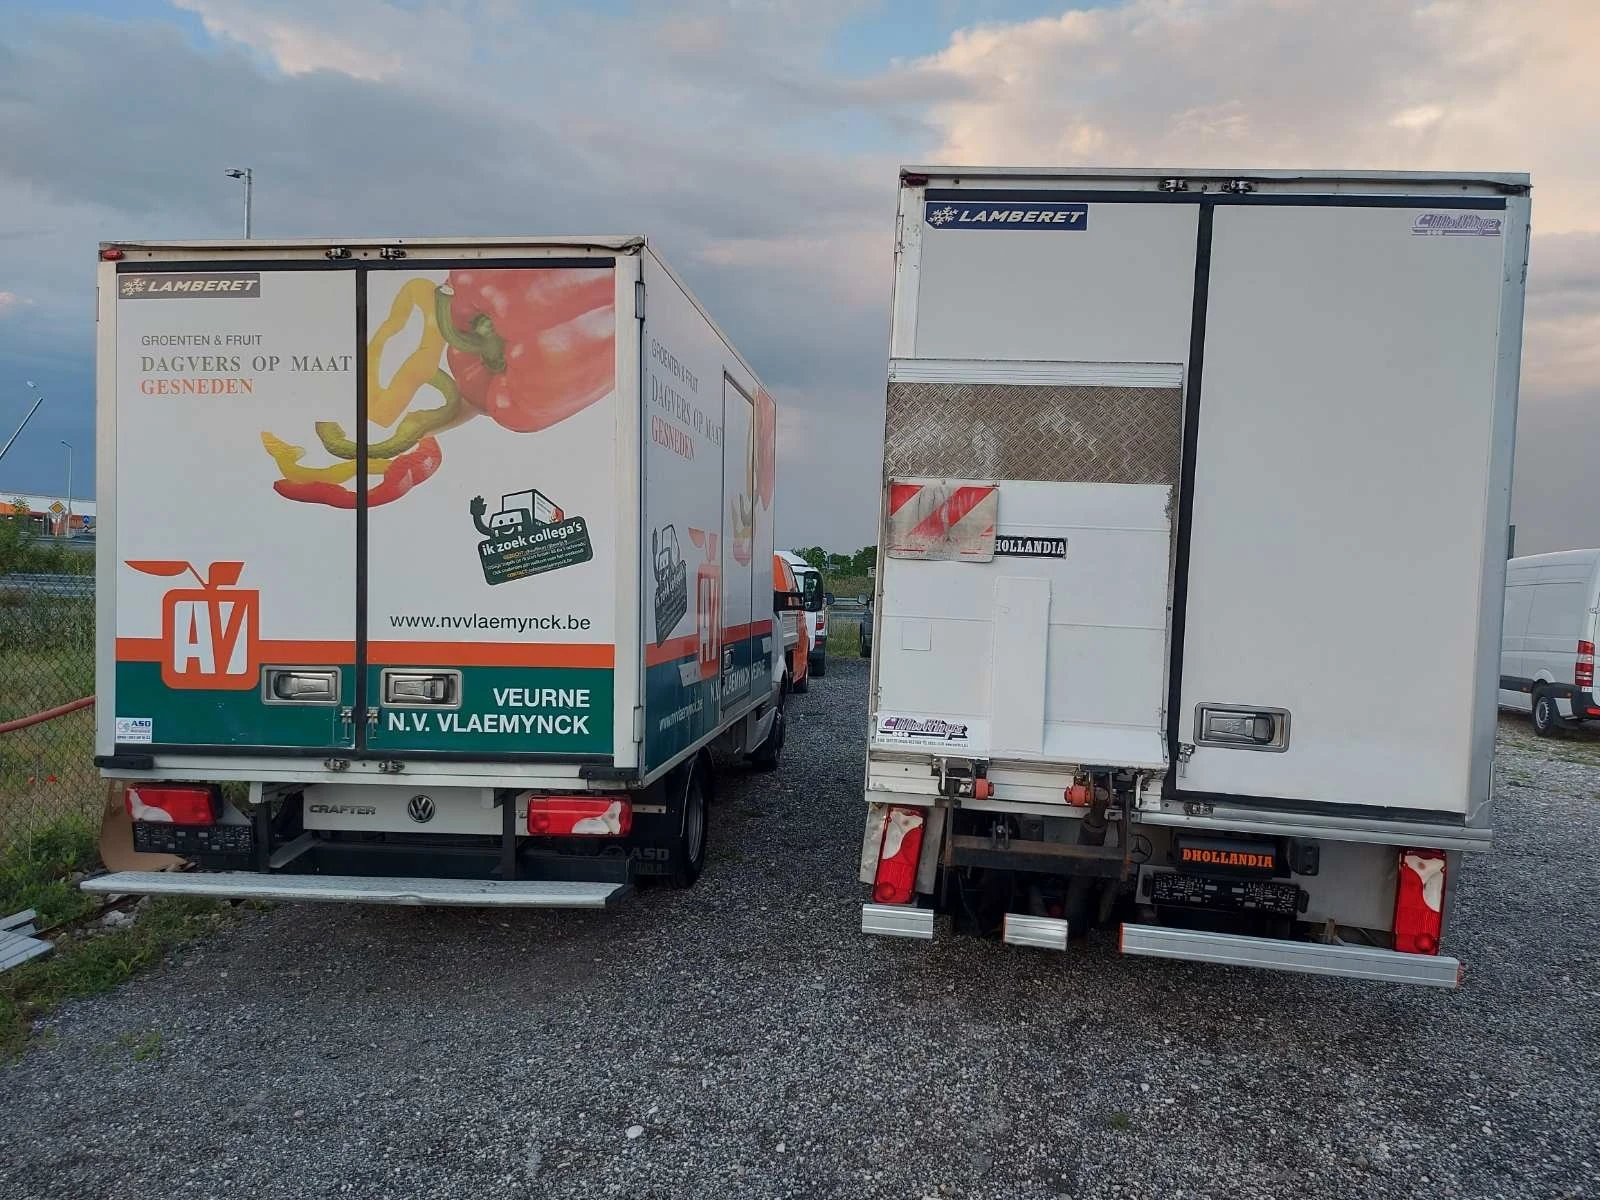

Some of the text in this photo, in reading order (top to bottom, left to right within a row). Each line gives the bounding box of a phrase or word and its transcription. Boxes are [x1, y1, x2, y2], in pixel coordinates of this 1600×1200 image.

[959, 210, 1085, 223] LAMBERET
[148, 279, 257, 292] LAMBERET
[141, 335, 263, 346] GROENTEN & FRUIT
[141, 355, 352, 372] DAGVERS OP MAAT
[141, 378, 255, 395] GESNEDEN
[652, 375, 691, 426] DAGVERS
[651, 415, 696, 462] GESNEDEN
[482, 544, 496, 556] ik
[497, 535, 528, 552] zoek
[529, 521, 583, 544] collega's
[390, 613, 590, 632] www.nvvlaemynck.be
[174, 600, 248, 674] AV
[492, 687, 590, 708] VEURNE
[388, 712, 590, 734] N.V. VLAEMYNCK
[308, 804, 376, 815] CRAFTER
[631, 847, 670, 861] ASD
[1182, 848, 1273, 868] DHOLLANDIA
